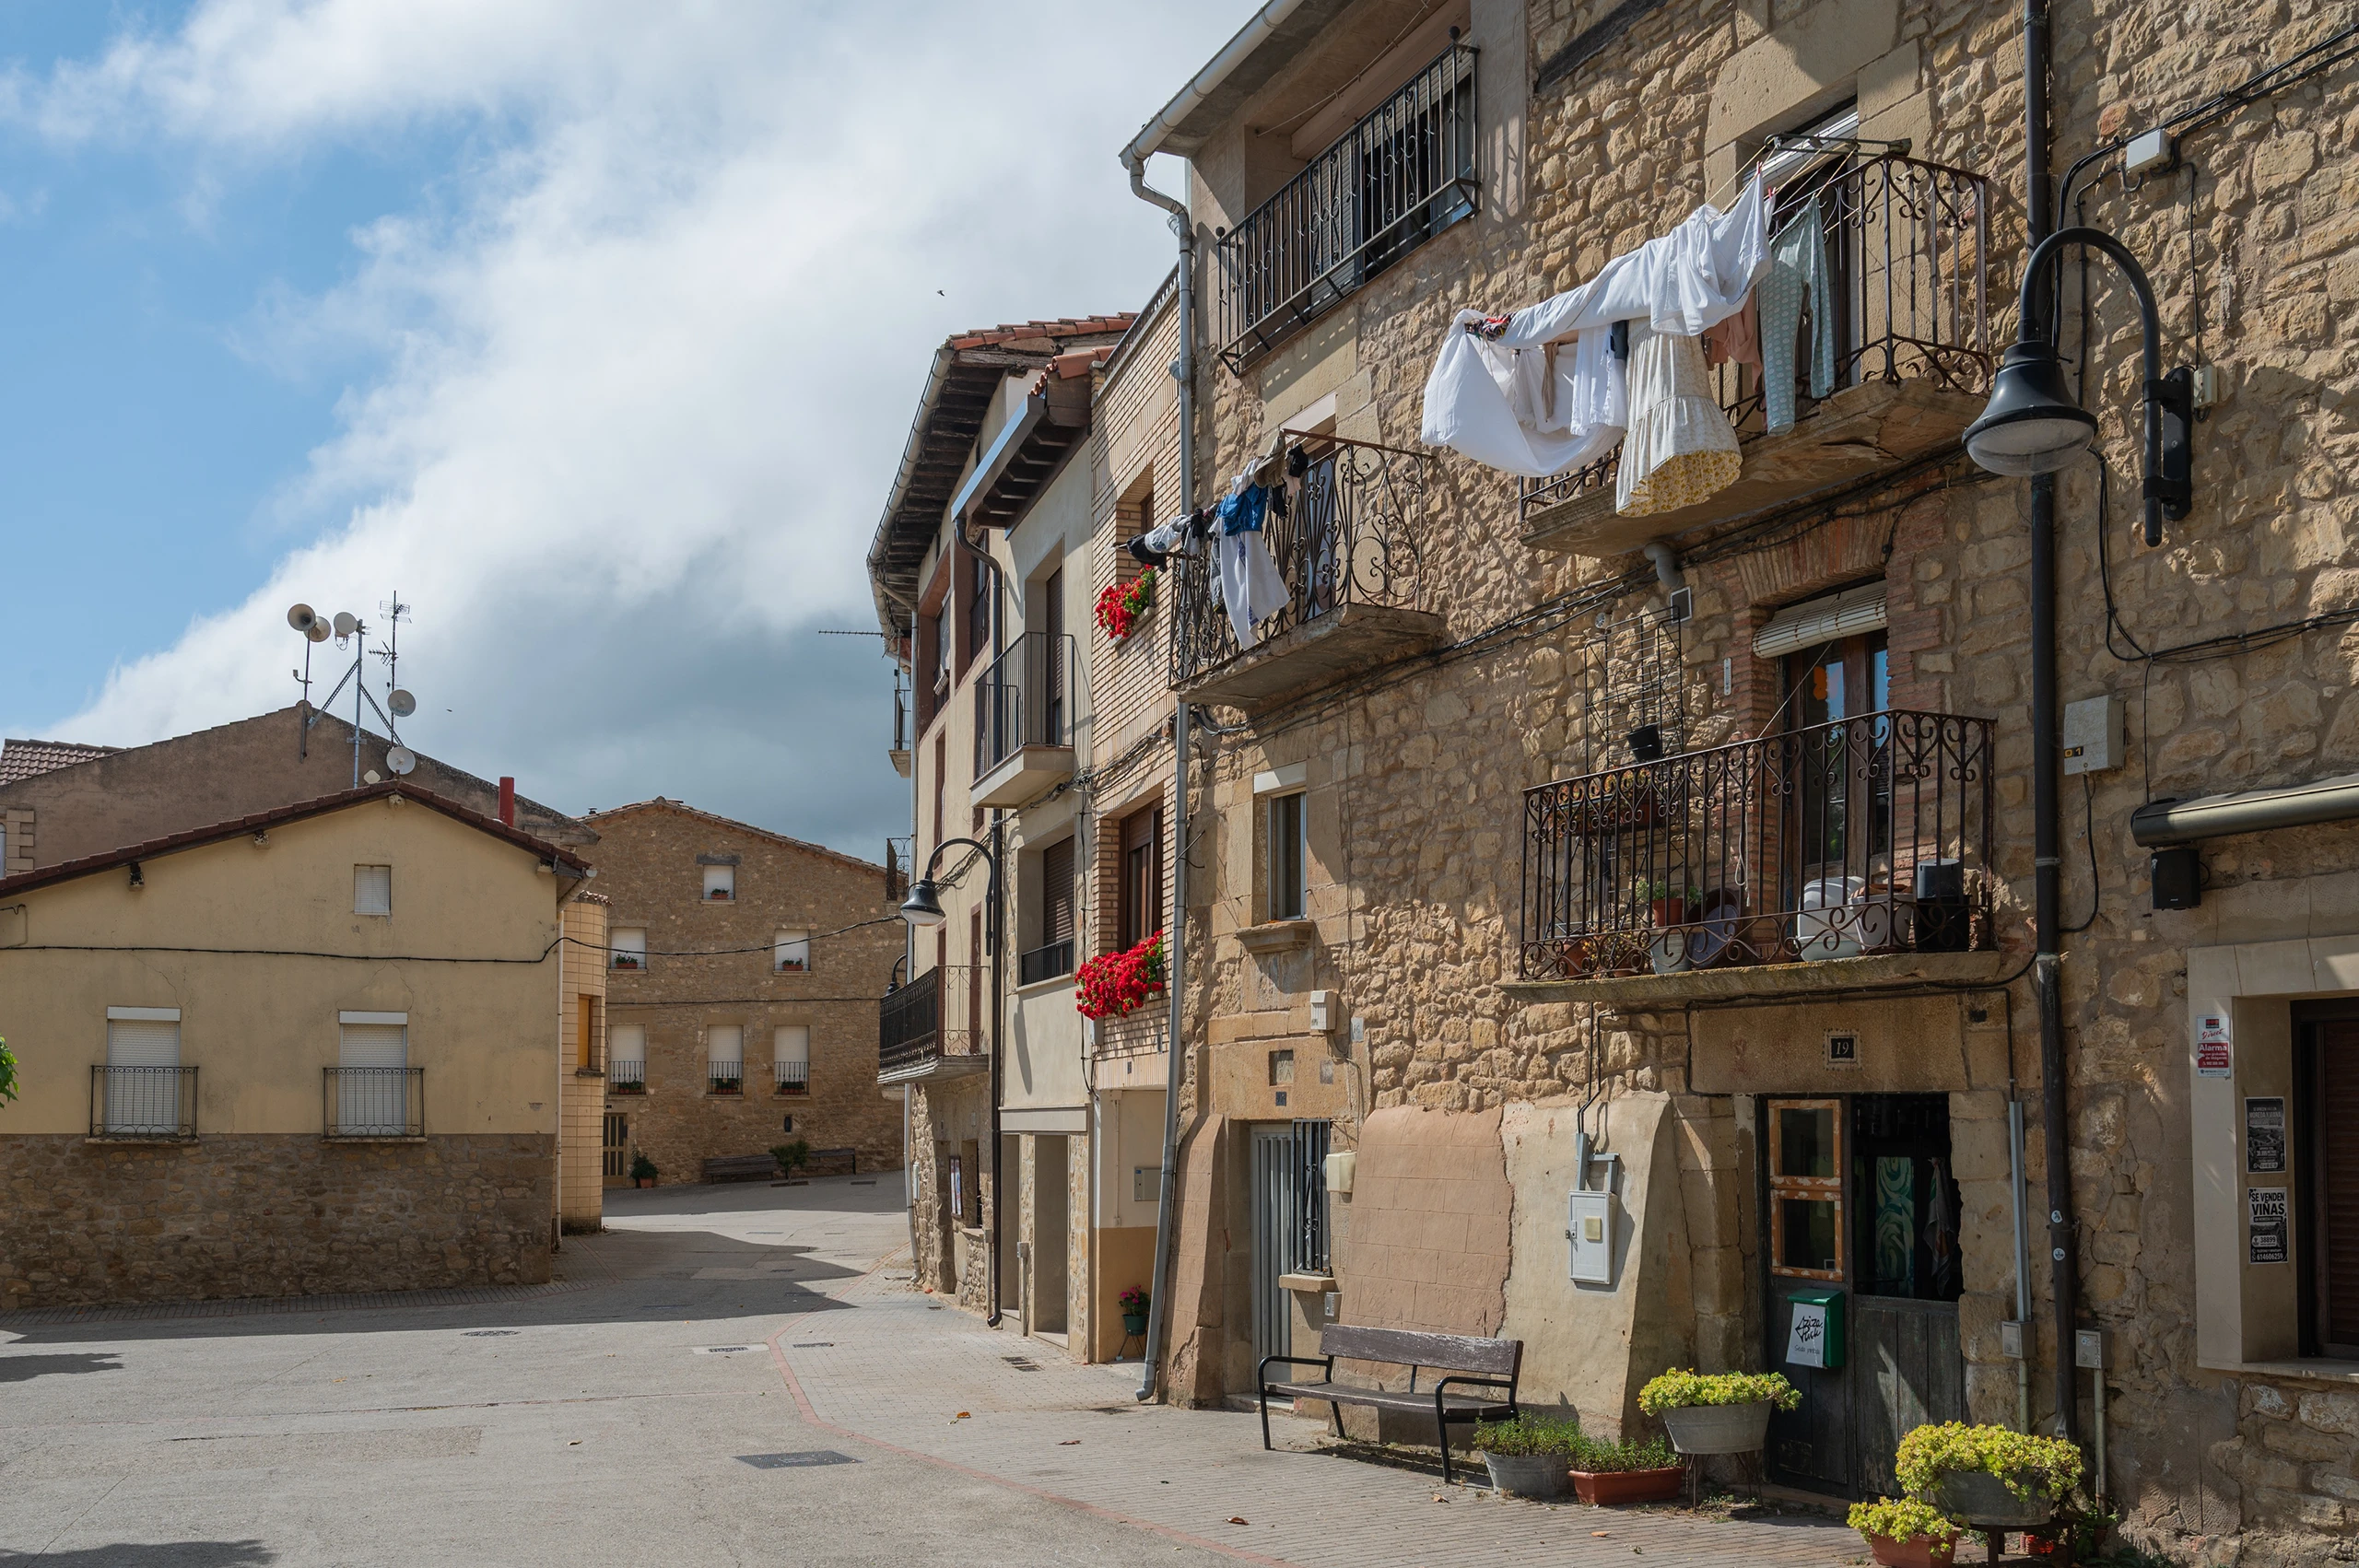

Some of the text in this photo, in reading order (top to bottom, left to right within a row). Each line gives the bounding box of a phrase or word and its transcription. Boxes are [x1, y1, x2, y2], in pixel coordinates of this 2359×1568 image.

[1836, 1041, 1849, 1055] 19
[2251, 1192, 2285, 1202] SE VENDEN
[2251, 1200, 2285, 1215] VIÑAS
